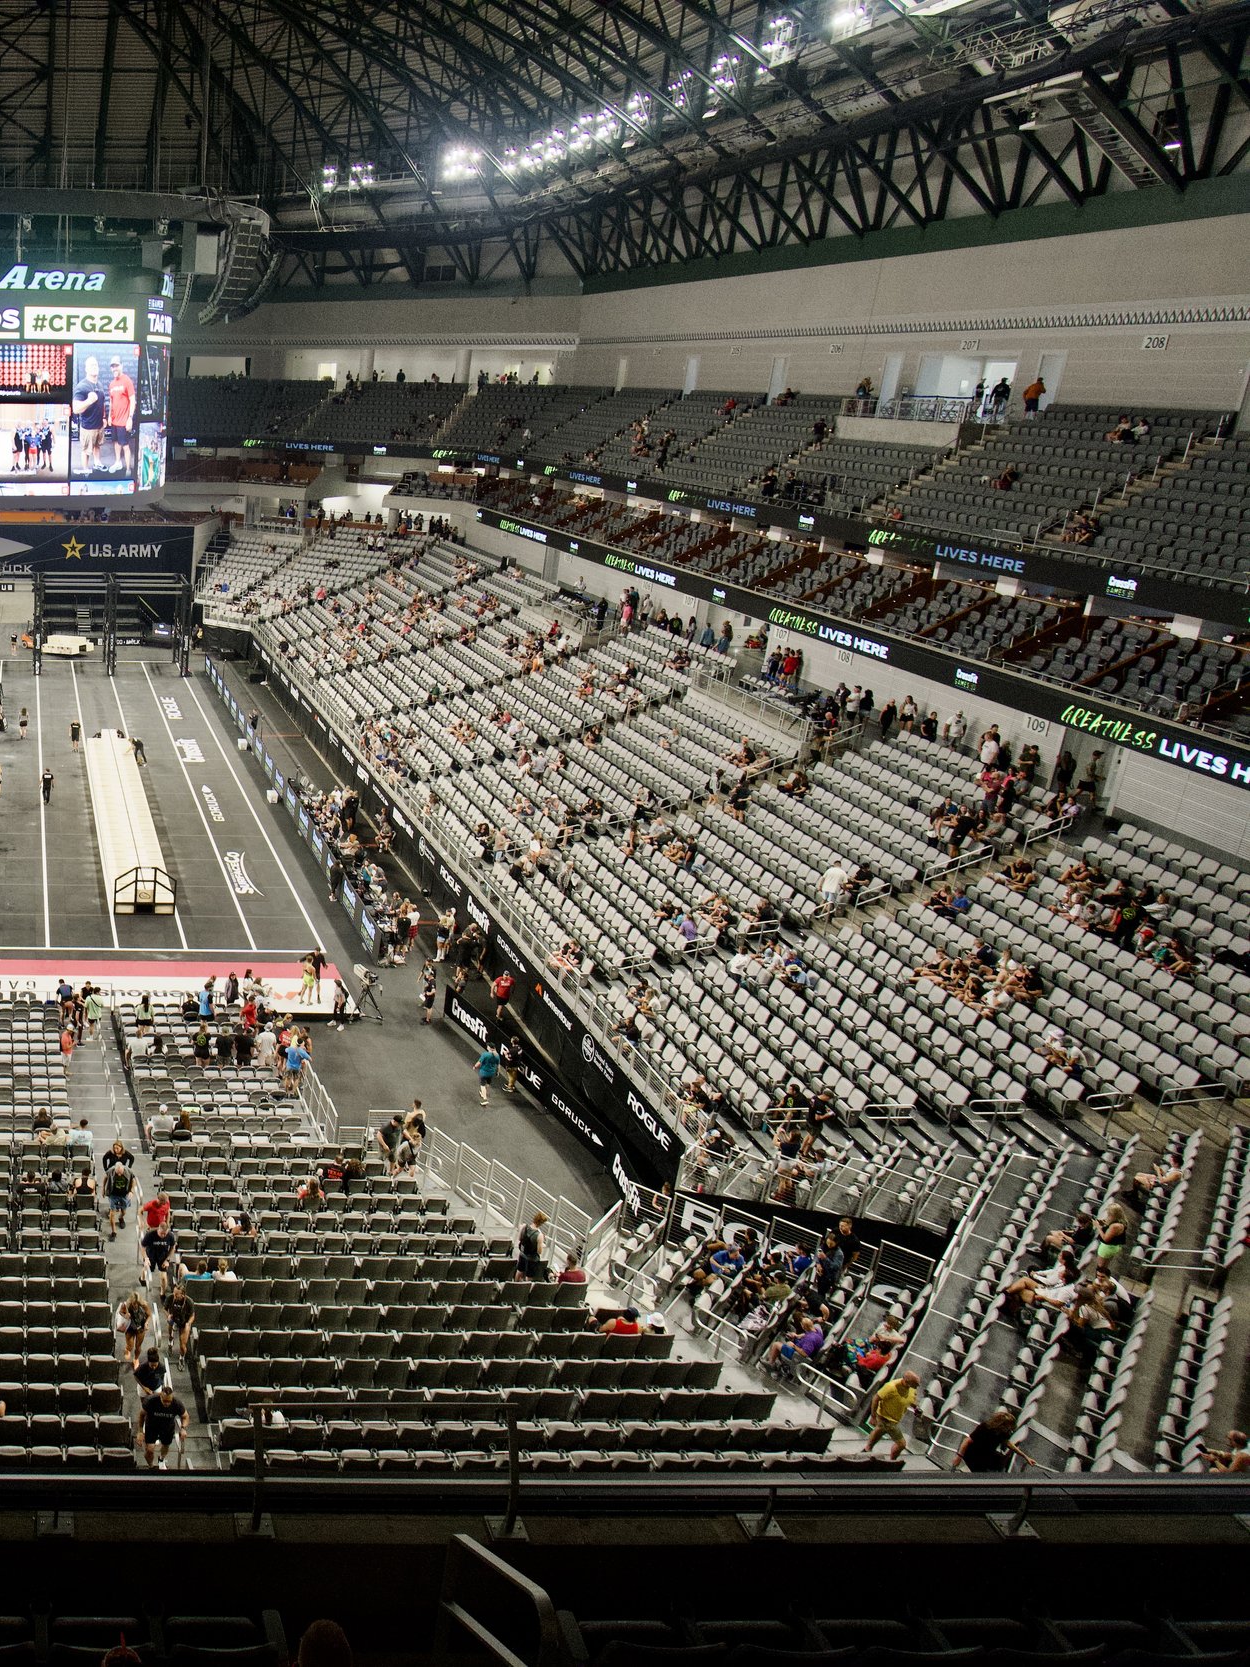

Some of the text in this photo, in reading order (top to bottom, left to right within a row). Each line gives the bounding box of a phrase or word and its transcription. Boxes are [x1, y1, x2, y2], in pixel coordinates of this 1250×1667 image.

[32, 314, 129, 333] #CFG24
[962, 340, 977, 350] 207
[1145, 337, 1165, 349] 208
[286, 442, 309, 450] LIVES
[569, 471, 601, 485] LIVES HERE
[707, 499, 756, 517] LIVES HERE
[90, 544, 162, 558] U.S. ARMY
[936, 544, 1025, 573] LIVES HERE
[635, 564, 655, 580] LIVES
[655, 571, 676, 586] HERE
[769, 607, 888, 659] GREATNESS LIVES HERE
[776, 628, 787, 639] 107
[838, 650, 850, 662] 108
[160, 696, 184, 720] ROGUE
[1026, 716, 1045, 733] 109
[176, 737, 206, 763] CrossFit
[1061, 705, 1156, 749] GREATNESS
[1159, 738, 1226, 775] LIVES
[203, 792, 225, 822] GORUCK
[440, 865, 462, 897] ROGUE
[452, 998, 488, 1042] CrossFit
[500, 1043, 543, 1090] RGUE
[551, 1093, 591, 1137] GORUCK
[627, 1091, 672, 1151] ROGUE
